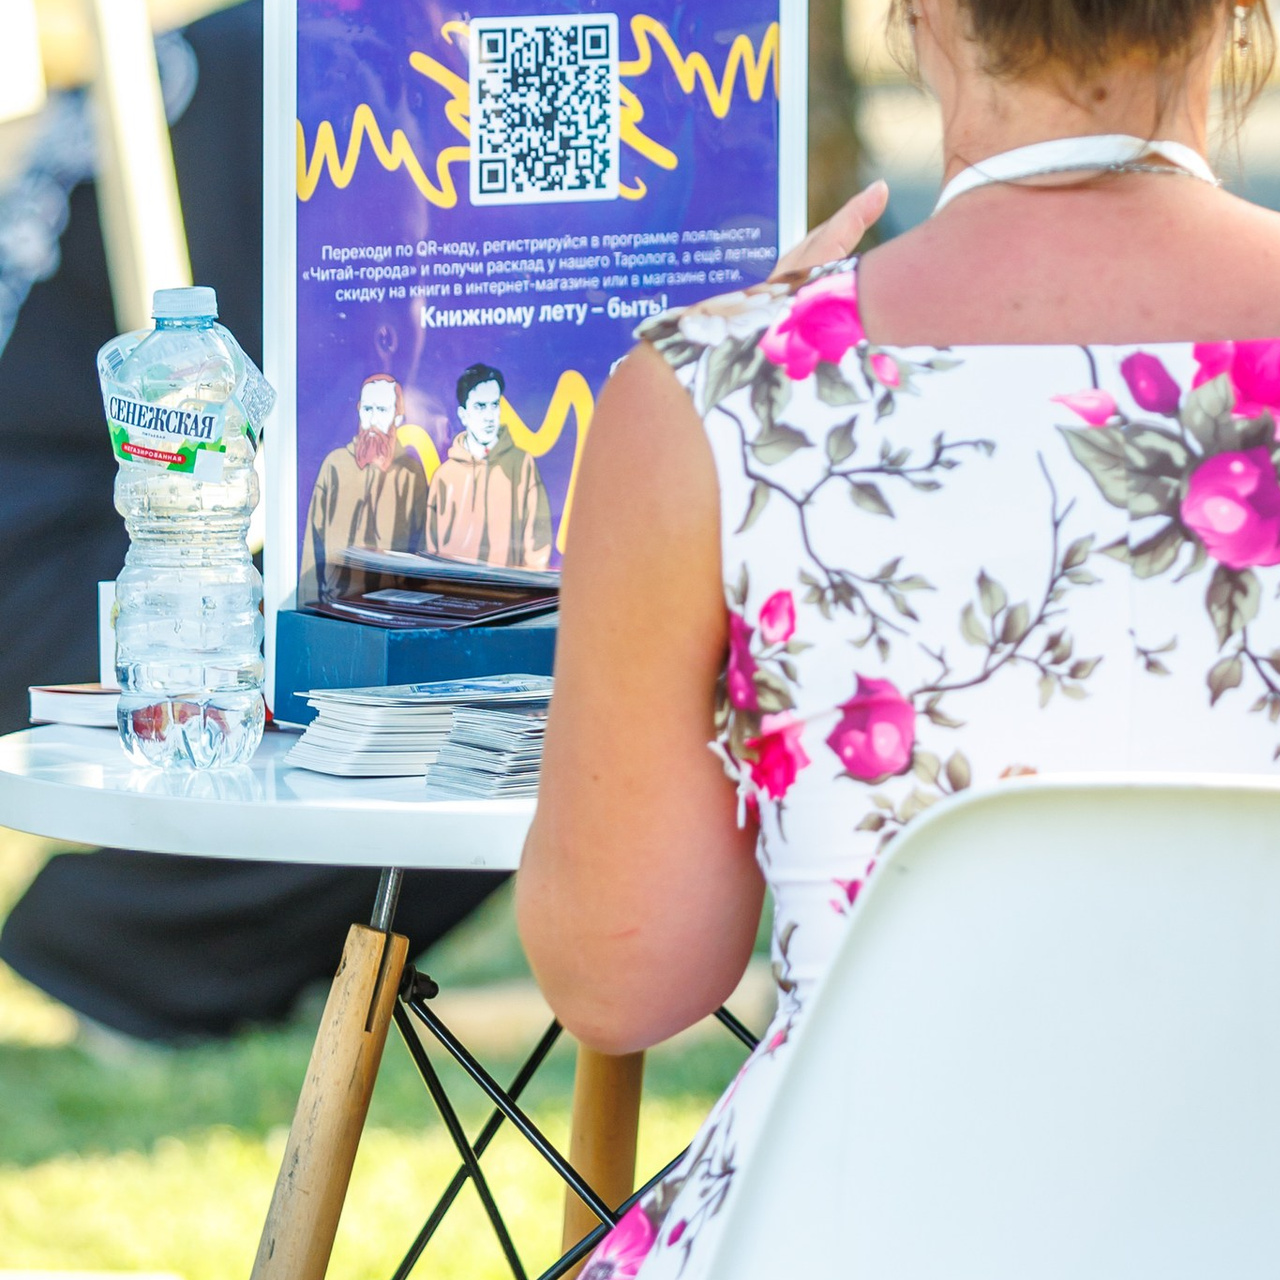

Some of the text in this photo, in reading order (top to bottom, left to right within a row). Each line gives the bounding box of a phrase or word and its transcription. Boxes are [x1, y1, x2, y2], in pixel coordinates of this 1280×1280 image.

[321, 226, 761, 263] Переходи по QR-коду, регистрируйся в программе лояльности
[303, 264, 417, 283] «Читай-города»
[420, 265, 430, 276] и
[433, 262, 484, 279] получи
[486, 258, 545, 277] расклад
[547, 257, 557, 273] у
[559, 254, 611, 270] нашего
[613, 249, 679, 269] Таролога,
[682, 252, 691, 265] а
[693, 246, 722, 264] ещё
[335, 286, 386, 303] скидку
[389, 286, 407, 299] на
[409, 282, 451, 298] книги
[453, 282, 463, 296] в
[465, 274, 600, 296] интернет-магазине
[602, 273, 629, 289] или
[630, 272, 640, 286] в
[642, 269, 706, 287] магазине
[420, 305, 535, 329] Книжному
[538, 300, 588, 326] лету
[607, 293, 668, 319] быть!
[109, 395, 216, 440] СЕНЕЖСКАЯ
[123, 444, 183, 462] НЕГАЗИРОВАННАЯ
